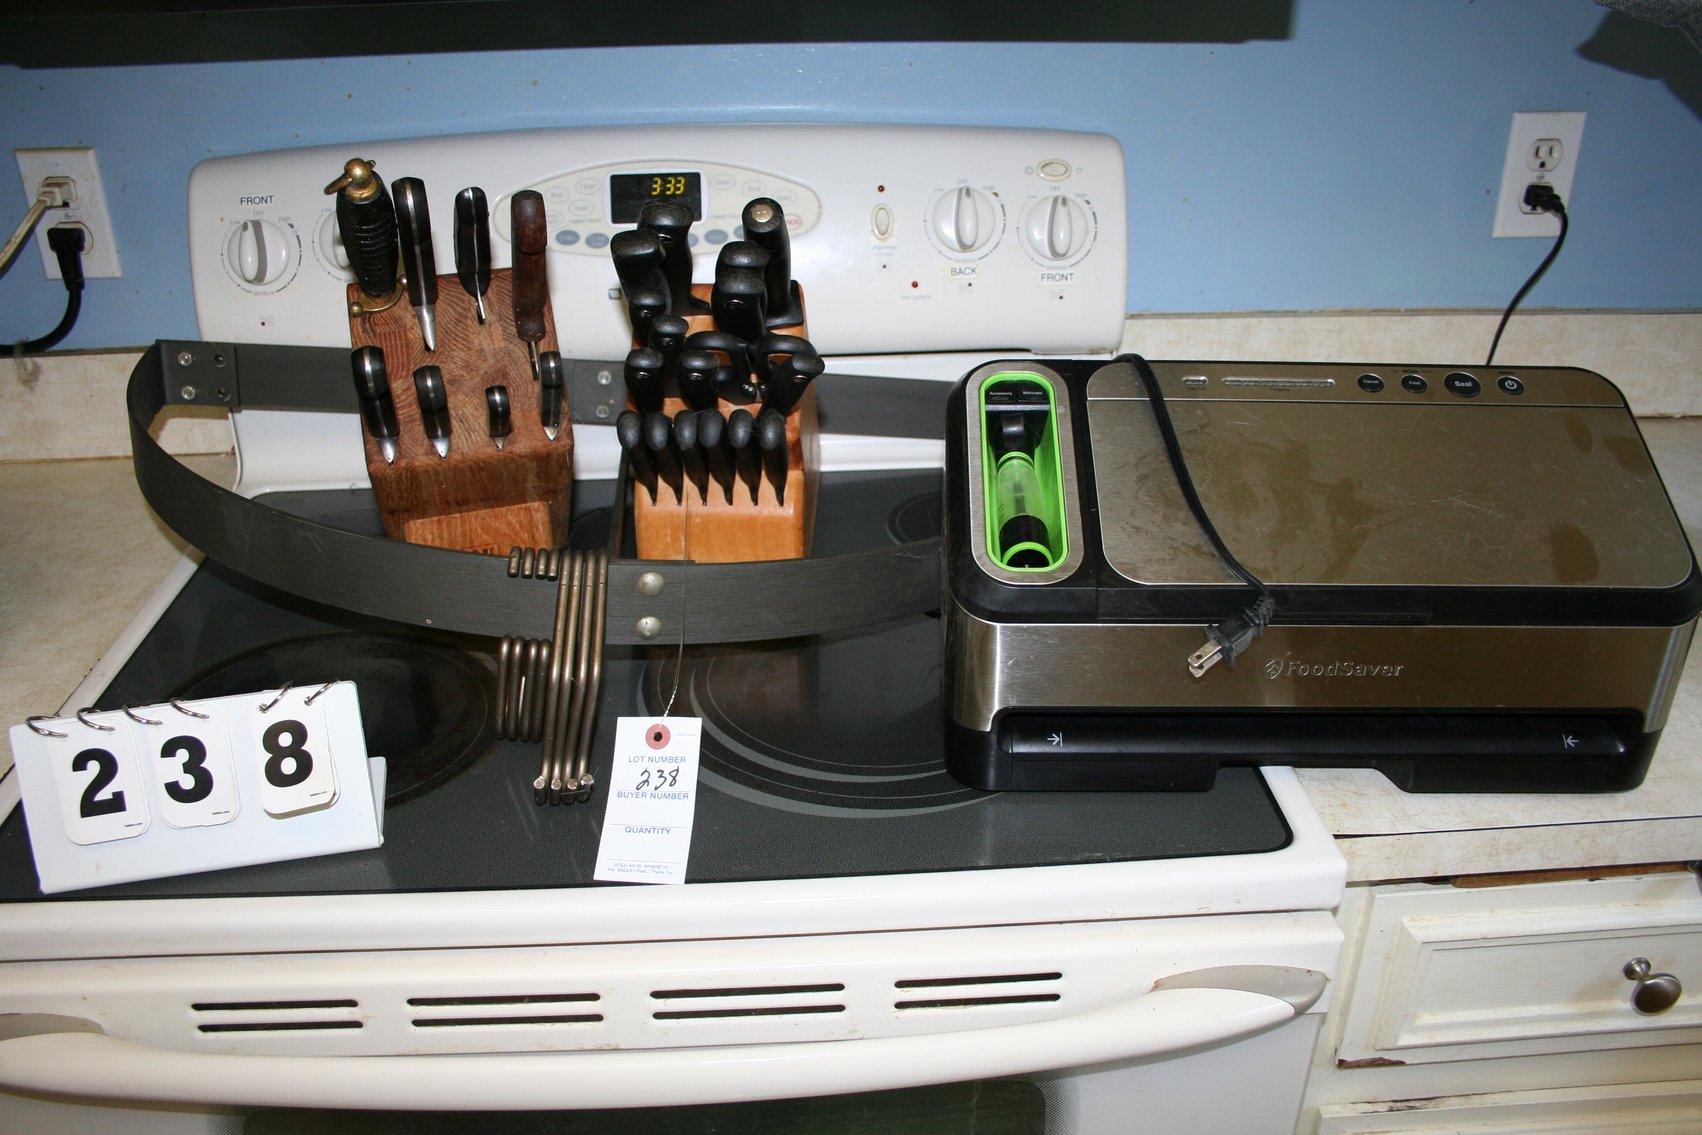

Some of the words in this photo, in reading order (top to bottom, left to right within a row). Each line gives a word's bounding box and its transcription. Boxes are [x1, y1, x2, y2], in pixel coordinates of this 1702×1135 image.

[650, 176, 686, 196] 3:33
[240, 195, 274, 206] FRONT
[950, 267, 977, 277] BACK
[1040, 272, 1074, 282] FRONT
[1286, 660, 1404, 677] FoodSaver
[628, 755, 645, 763] LOT
[647, 756, 686, 764] NUMBER
[636, 765, 680, 791] 238
[617, 791, 647, 799] BUYER
[649, 792, 689, 800] NUMBER
[624, 826, 671, 835] QUANTITY
